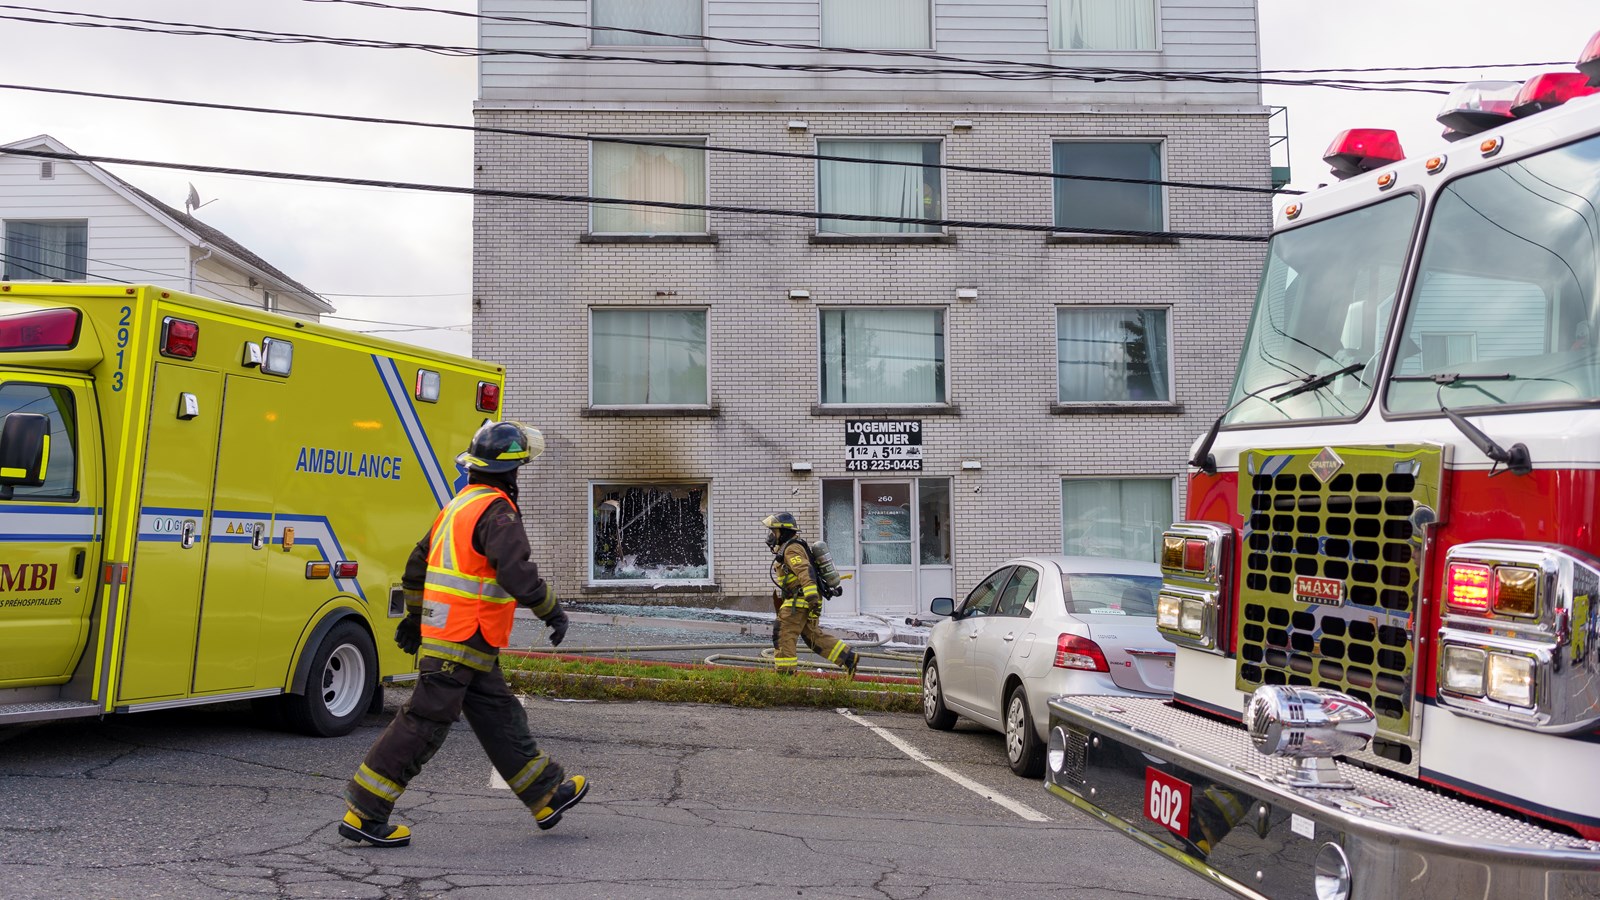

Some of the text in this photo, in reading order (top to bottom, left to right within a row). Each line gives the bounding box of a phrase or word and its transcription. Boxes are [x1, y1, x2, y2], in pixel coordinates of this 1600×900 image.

[111, 306, 131, 392] 2913
[847, 422, 919, 433] LOGEMENTS
[857, 432, 909, 445] À LOUER
[295, 447, 402, 480] AMBULANCE
[848, 460, 920, 470] 418 225-0445
[1311, 461, 1337, 469] SPARTAN
[244, 522, 253, 533] G2
[1298, 580, 1339, 596] MAXI
[5, 598, 62, 607] PRÉHOSPITALIERS
[441, 661, 457, 674] 54
[1150, 780, 1182, 831] 602
